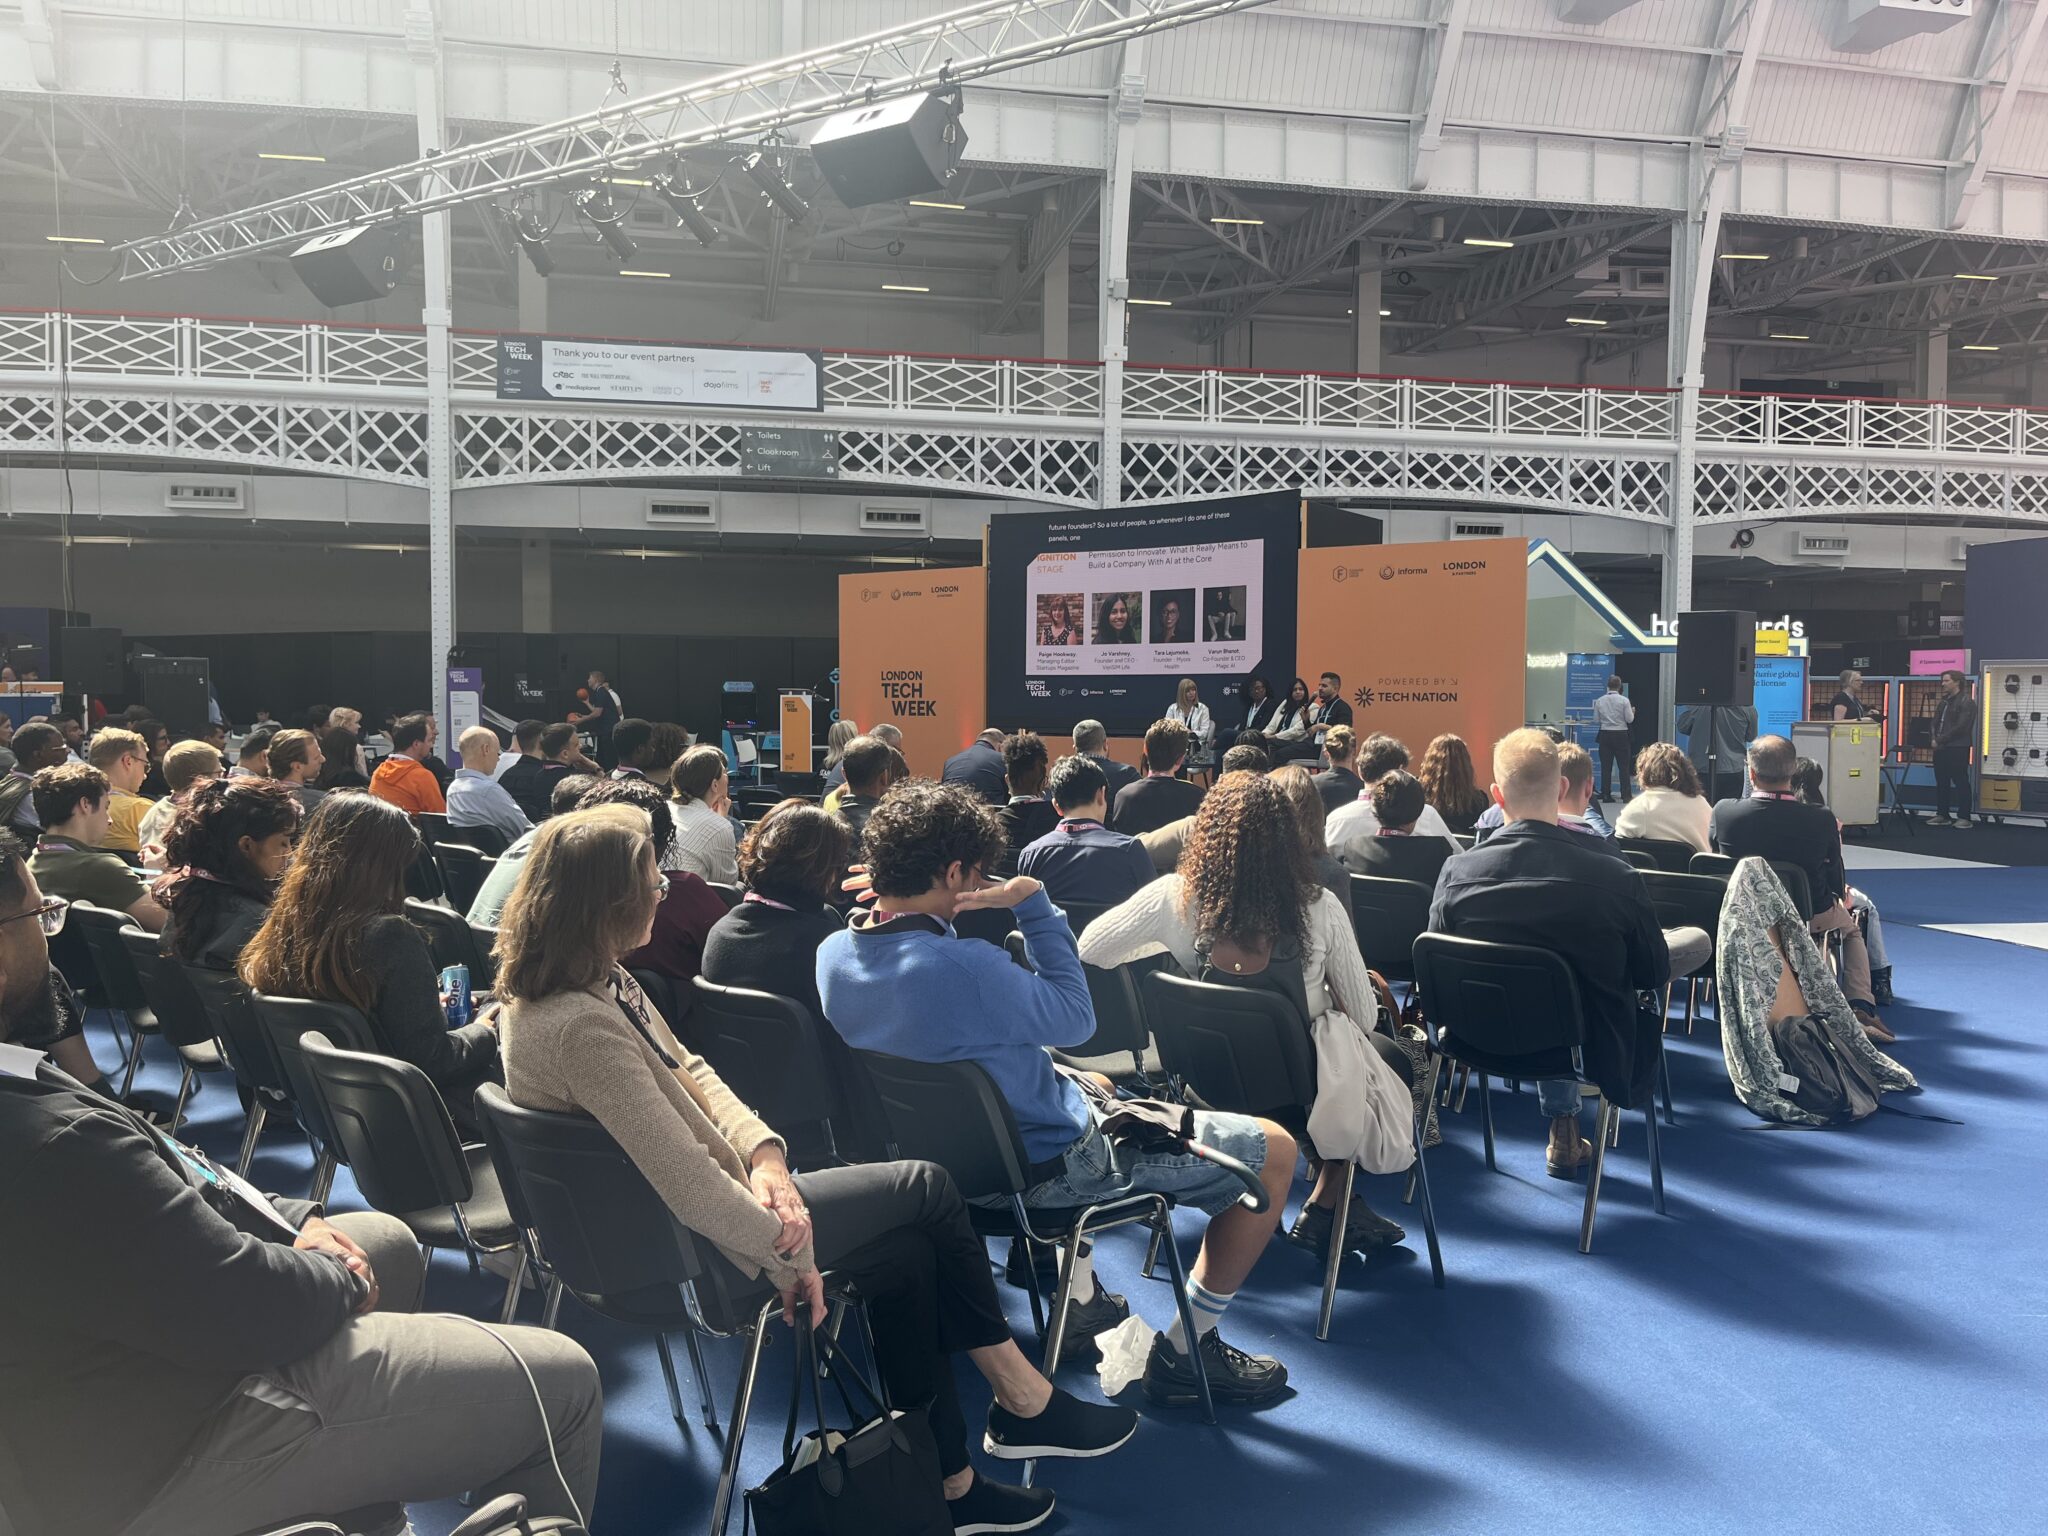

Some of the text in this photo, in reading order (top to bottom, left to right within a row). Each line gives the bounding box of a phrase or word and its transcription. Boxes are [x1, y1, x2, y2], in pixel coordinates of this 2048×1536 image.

[510, 353, 533, 361] WEEK
[553, 348, 580, 357] Thank
[582, 351, 599, 360] you
[602, 351, 611, 359] to
[630, 353, 655, 361] event
[657, 354, 695, 363] partners
[565, 383, 601, 391] mediaplanet
[703, 381, 739, 389] dojofilms
[757, 431, 781, 440] Toilets
[757, 447, 799, 456] Cloakroom
[1067, 522, 1096, 530] founders?
[1126, 519, 1147, 528] people,
[1156, 517, 1184, 525] whenever
[1048, 535, 1068, 543] panels,
[1088, 551, 1126, 559] Permission
[1169, 546, 1188, 554] What
[1196, 544, 1217, 553] Really
[1217, 542, 1239, 550] Means
[1240, 541, 1248, 549] to
[1037, 553, 1077, 562] IGNITION
[1088, 561, 1106, 569] Build
[1113, 560, 1146, 569] Company
[1147, 558, 1164, 566] With
[1183, 556, 1194, 564] the
[1195, 555, 1213, 563] Core
[1037, 565, 1064, 574] STAGE
[1443, 561, 1486, 571] LONDON
[1398, 567, 1428, 575] informa
[931, 585, 959, 594] LONDON
[881, 671, 922, 681] LONDON
[1778, 670, 1800, 679] global
[1378, 678, 1447, 686] POWERED BY
[1761, 679, 1787, 687] license
[881, 683, 922, 698] TECH
[1378, 692, 1458, 702] TECH NATION
[892, 700, 936, 716] WEEK
[448, 978, 462, 1009] one
